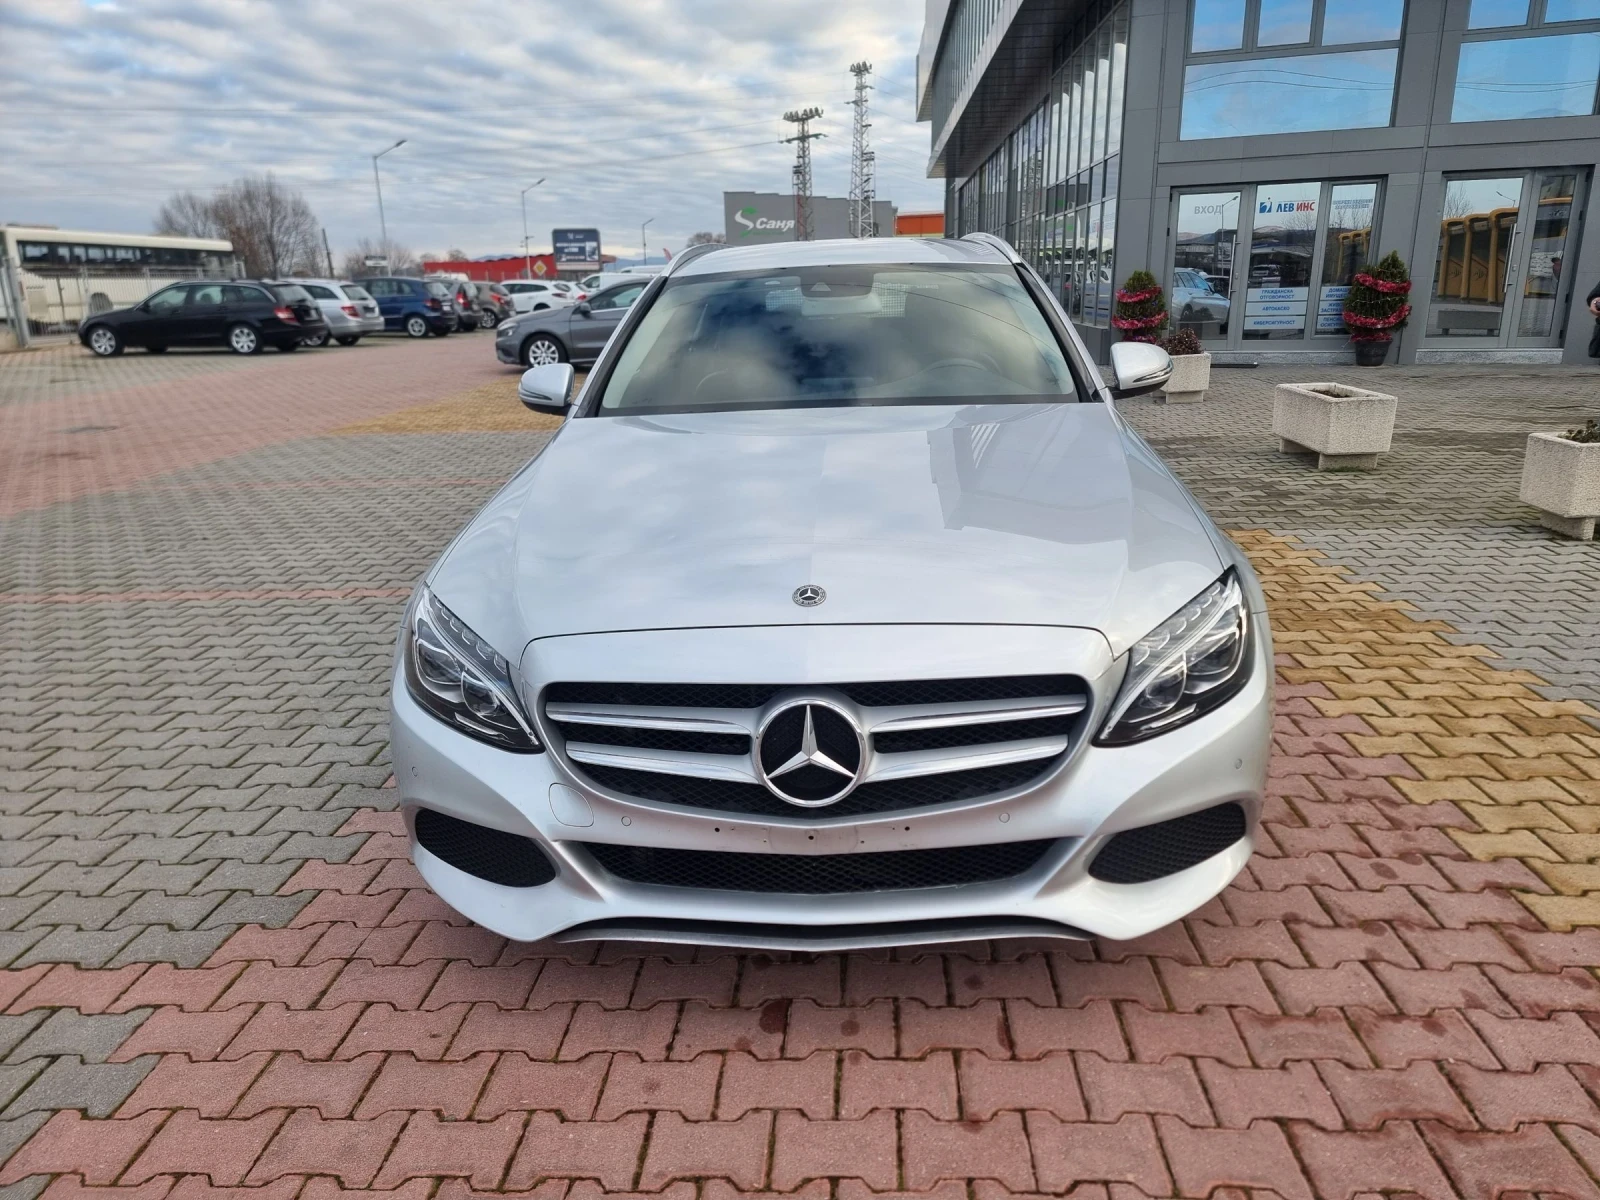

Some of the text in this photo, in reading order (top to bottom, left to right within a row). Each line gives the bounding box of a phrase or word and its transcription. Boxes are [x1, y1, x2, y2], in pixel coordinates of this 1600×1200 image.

[1194, 205, 1222, 215] ВХОД
[1276, 202, 1315, 212] ЛЕВ ИНС
[756, 218, 795, 232] Саня
